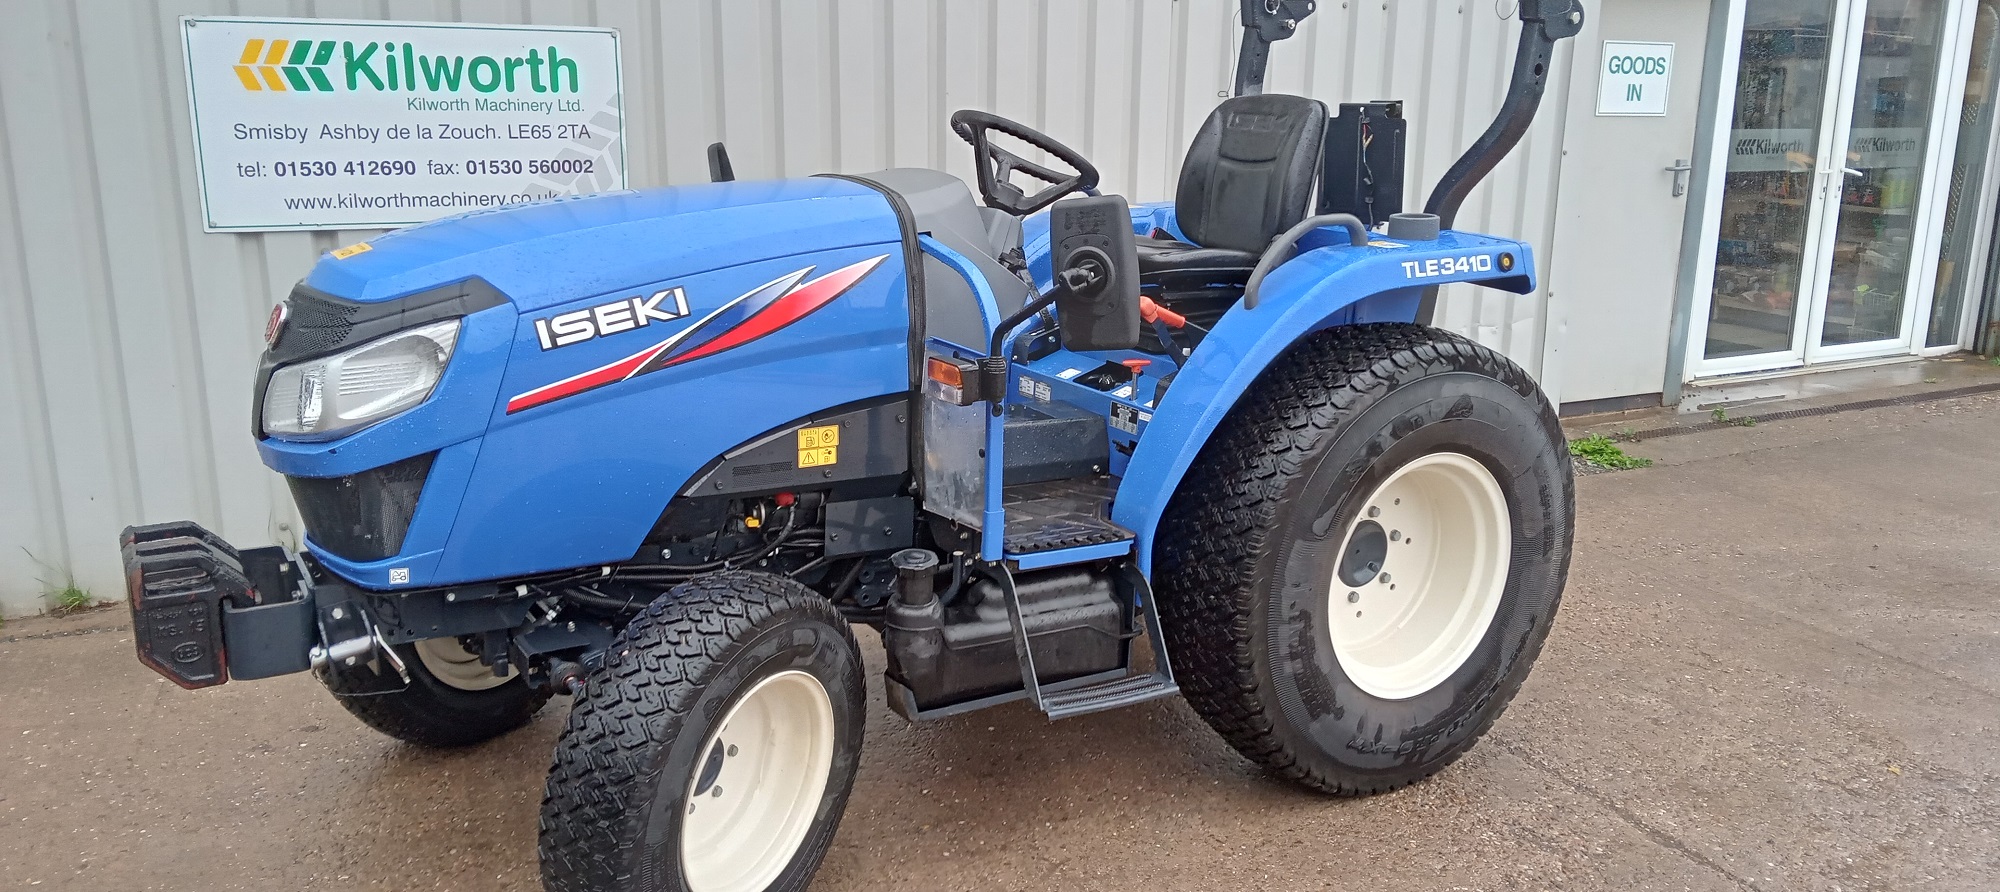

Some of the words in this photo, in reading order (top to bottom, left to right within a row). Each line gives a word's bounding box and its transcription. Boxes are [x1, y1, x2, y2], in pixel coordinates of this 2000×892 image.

[342, 41, 579, 93] Kilworth
[1608, 55, 1666, 75] GOODS
[1626, 84, 1643, 102] IN
[406, 97, 470, 112] Kilworth
[475, 98, 553, 115] Machinery
[558, 98, 585, 112] Ltd.
[233, 123, 308, 144] Smisby
[319, 123, 380, 144] Ashby
[386, 123, 410, 139] de
[416, 123, 433, 139] la
[438, 123, 501, 140] Zouch.
[507, 124, 551, 139] LE65
[557, 124, 591, 139] 2TA
[1755, 138, 1804, 155] Kilworth
[1872, 137, 1916, 152] Kilworth
[237, 161, 267, 178] tel:
[274, 161, 337, 177] 01530
[343, 160, 417, 176] 412690
[427, 159, 460, 175] fax:
[465, 159, 522, 175] 01530
[528, 159, 594, 174] 560002
[284, 190, 558, 210] www.kilworthmachinery.couk
[1401, 254, 1492, 279] TLE3410
[534, 286, 690, 351] ISEKI
